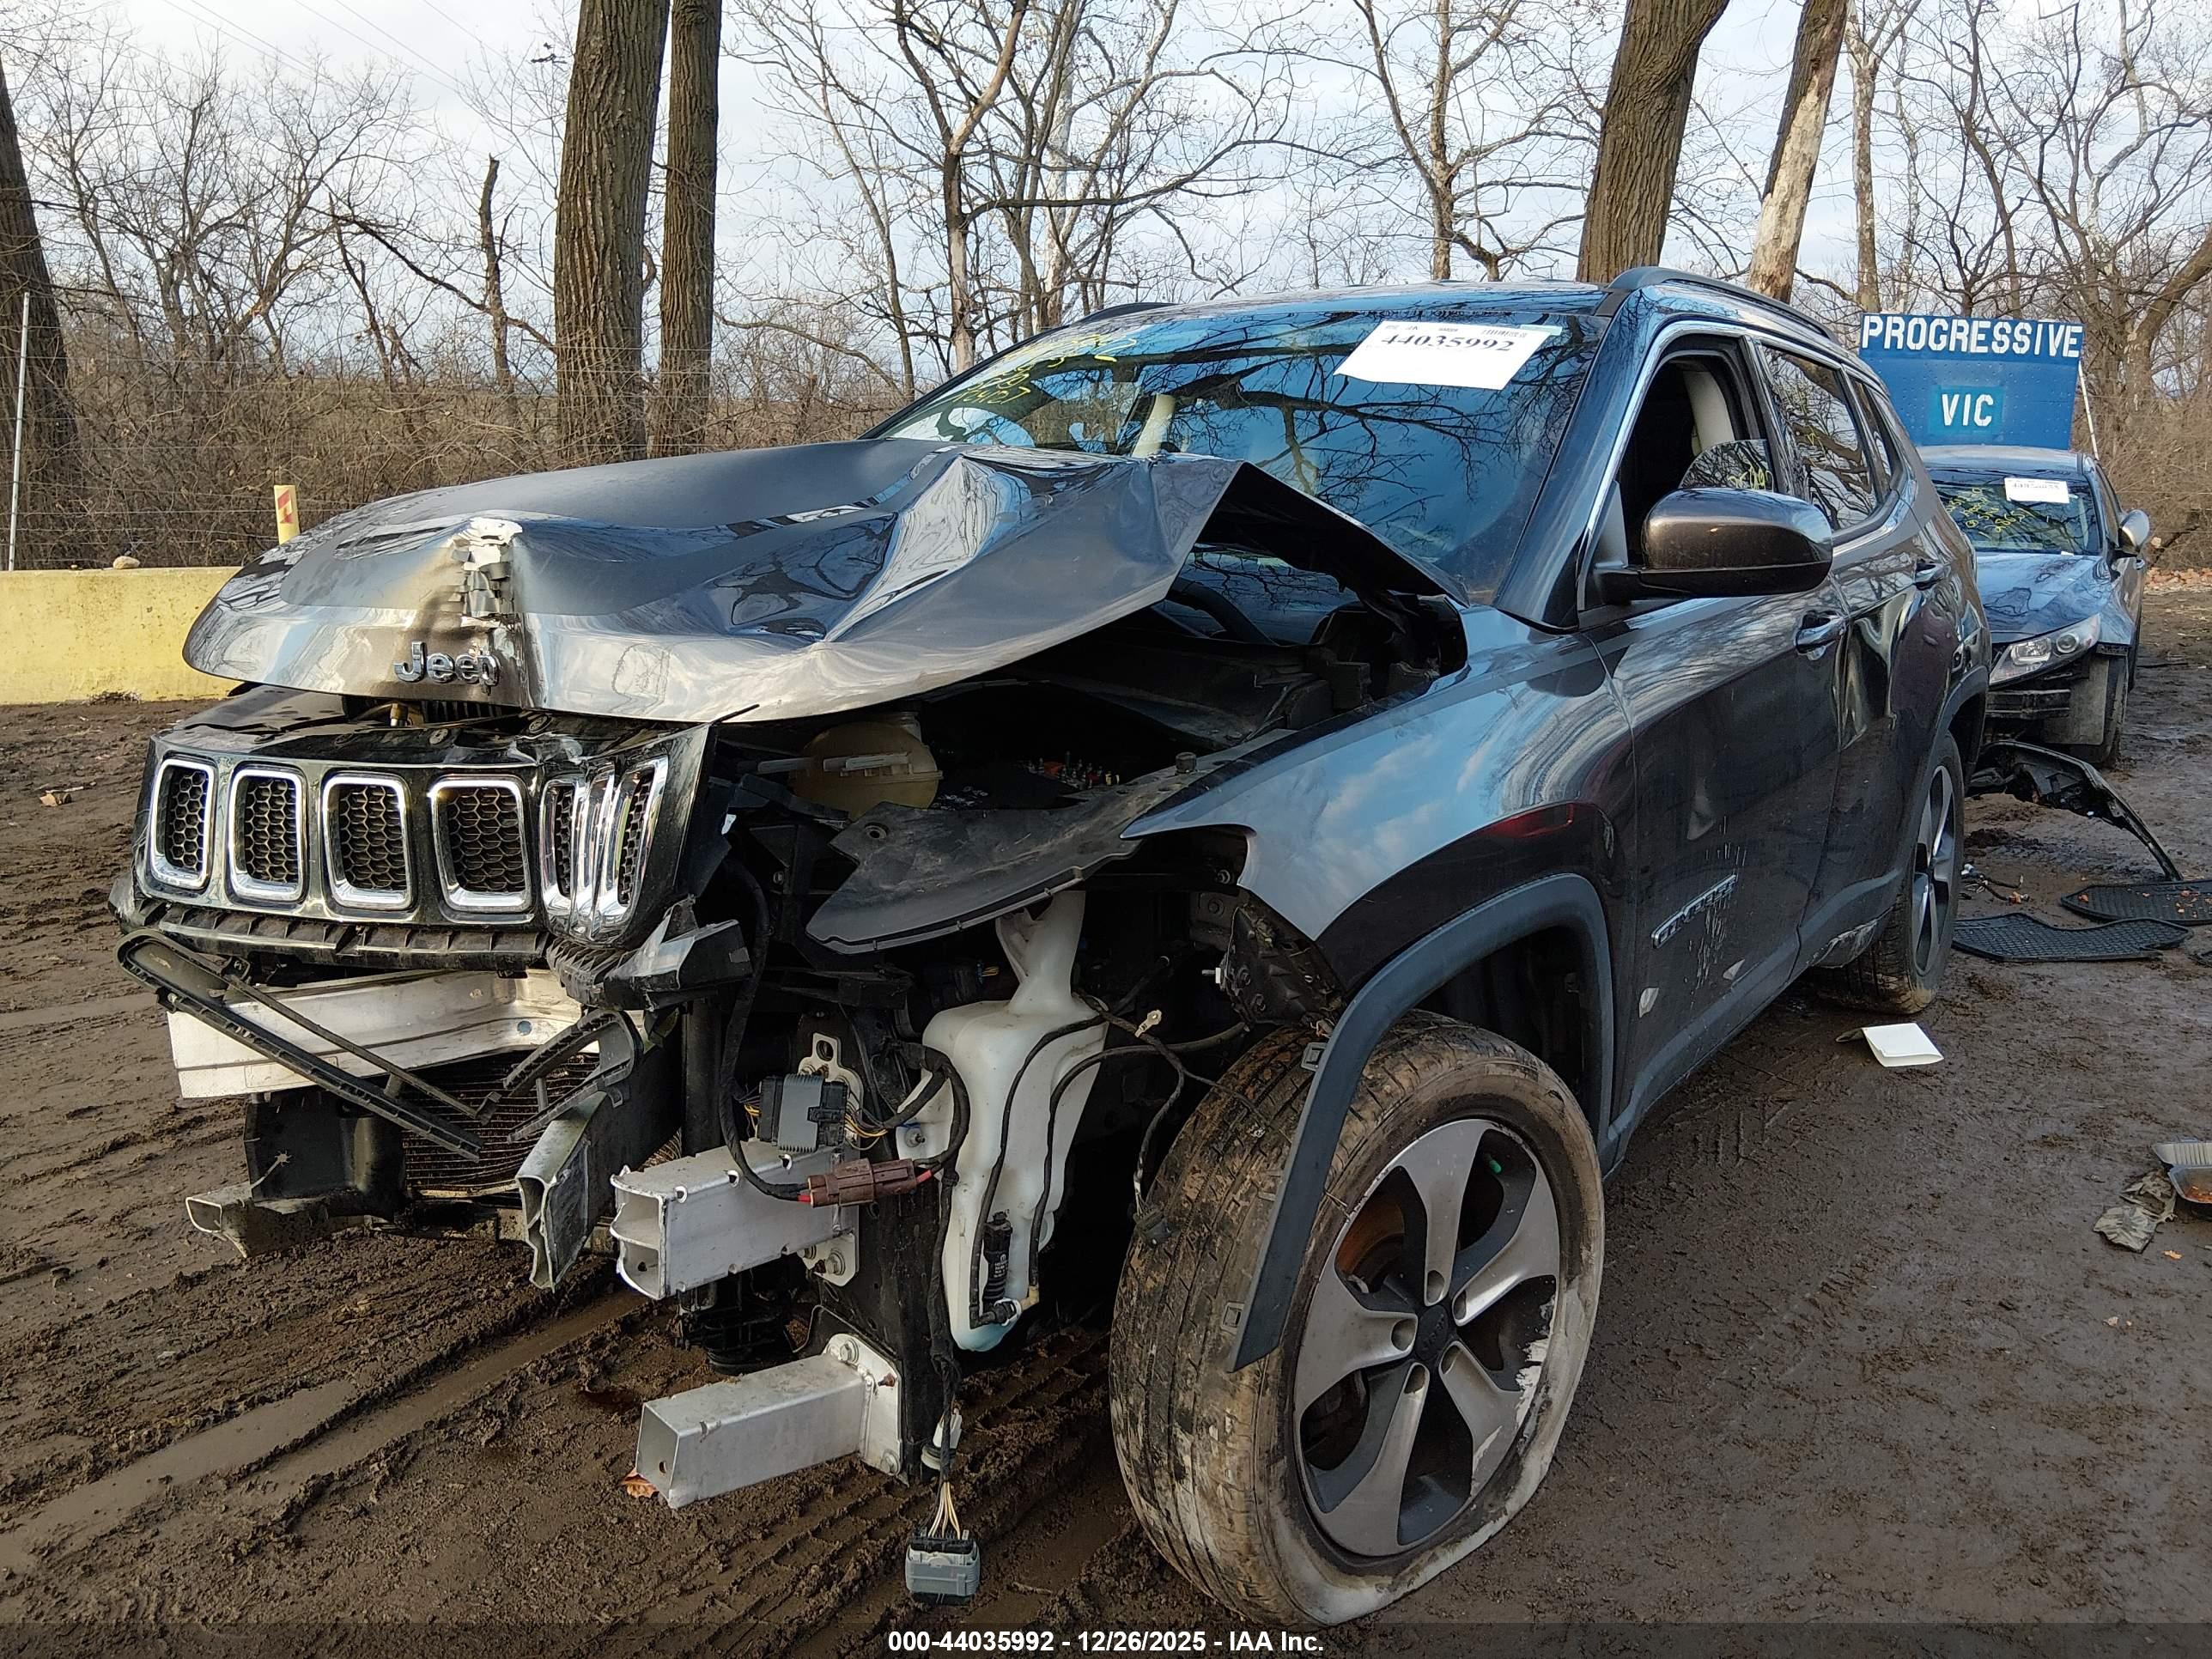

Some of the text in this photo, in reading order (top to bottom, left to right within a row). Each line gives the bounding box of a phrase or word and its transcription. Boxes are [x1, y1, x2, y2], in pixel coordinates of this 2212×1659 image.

[1381, 333, 1515, 352] 44035992
[1861, 314, 2084, 358] PROGRESSIVE
[1941, 392, 1994, 427] VIC
[393, 641, 502, 695] Jeep
